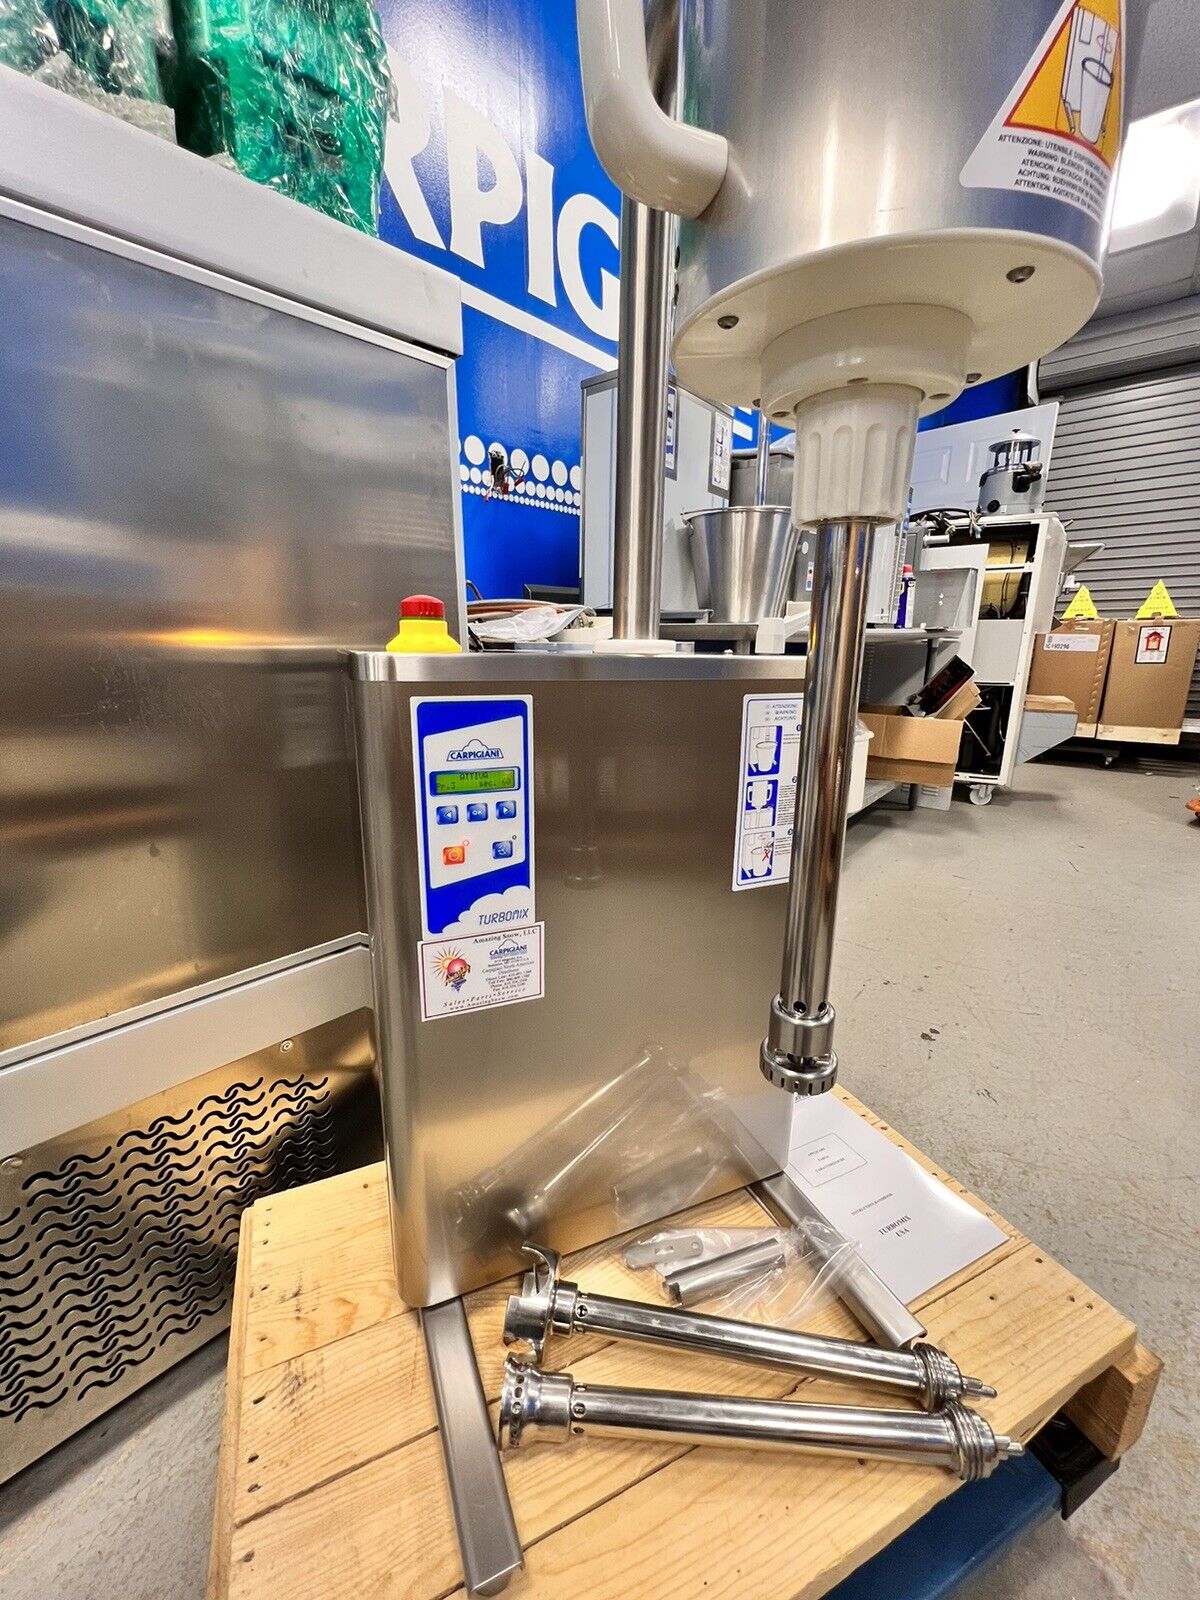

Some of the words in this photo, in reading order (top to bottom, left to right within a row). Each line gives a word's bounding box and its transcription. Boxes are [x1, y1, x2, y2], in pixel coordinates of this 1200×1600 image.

[450, 750, 500, 760] CARPIGIANI
[479, 908, 529, 925] TURBOMIX
[473, 935, 501, 944] Amazing
[489, 945, 527, 955] CARPIGIANI
[878, 1215, 912, 1235] TURBOMIX
